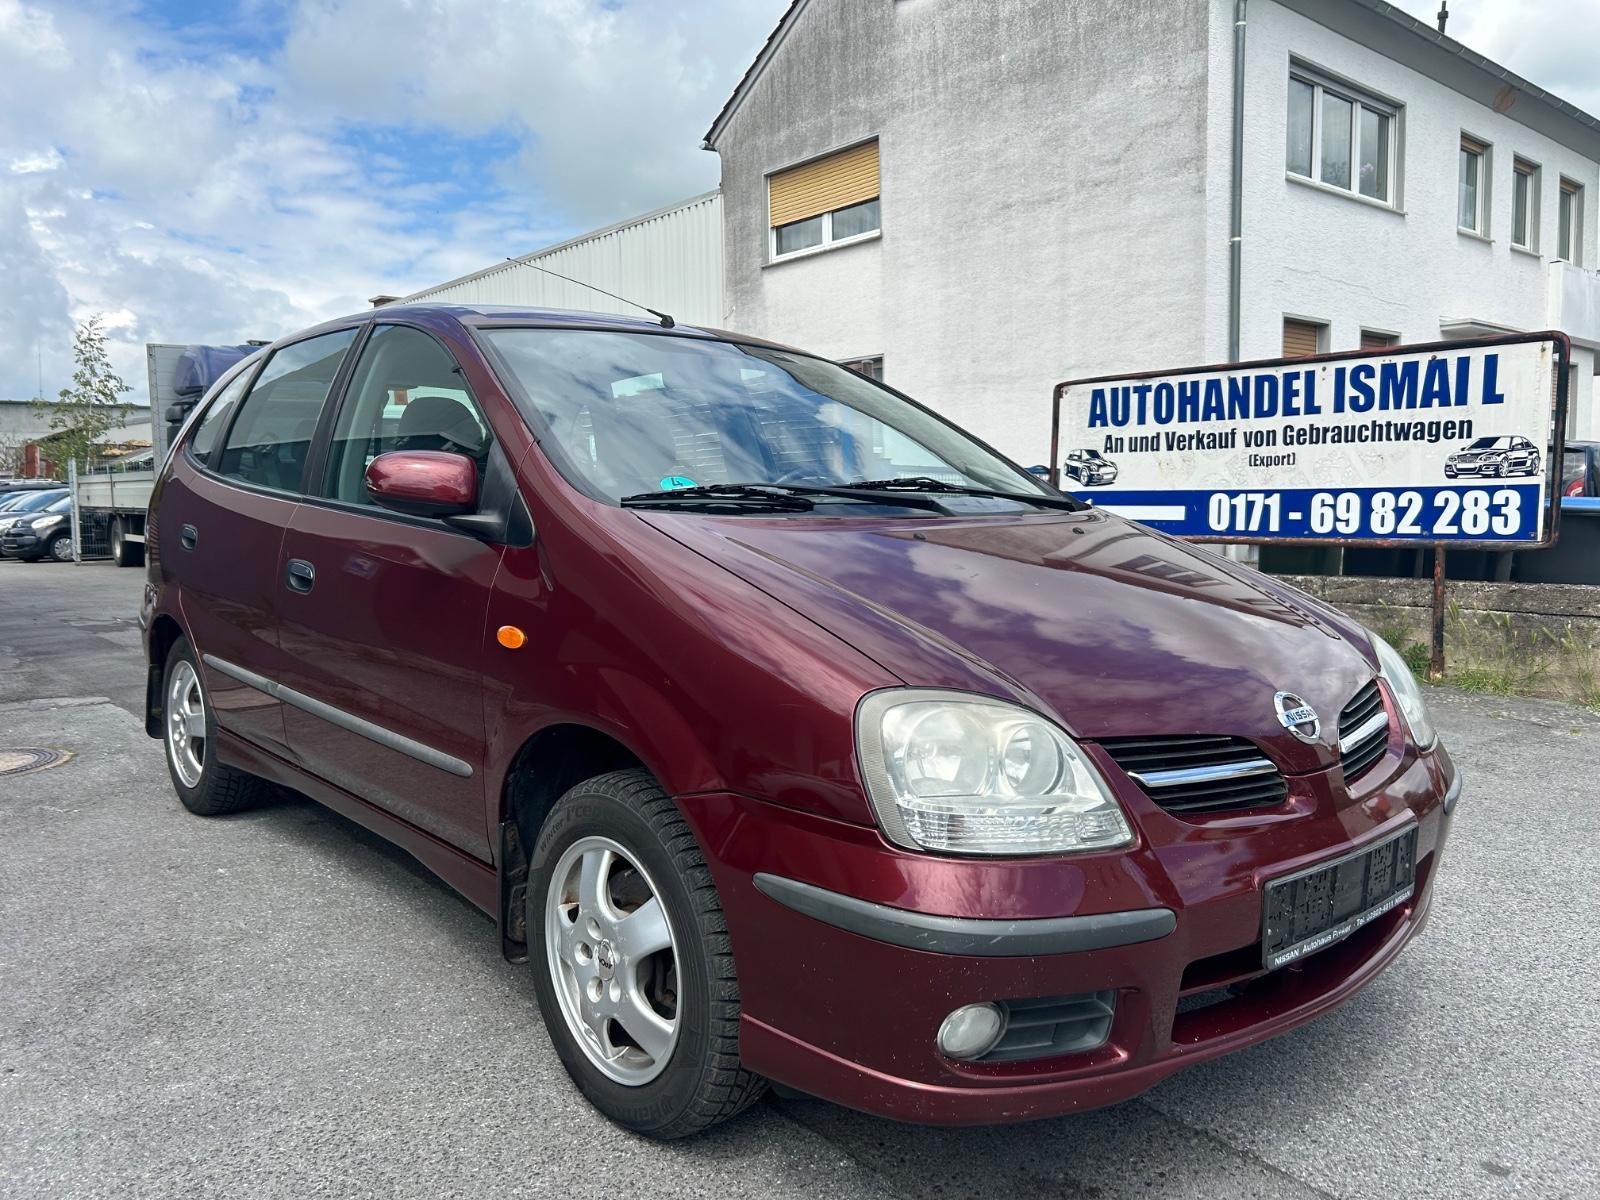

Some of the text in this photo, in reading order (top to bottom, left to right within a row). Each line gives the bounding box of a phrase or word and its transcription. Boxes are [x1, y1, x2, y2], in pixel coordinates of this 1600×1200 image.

[1088, 369, 1321, 428] AUTOHANDEL
[1103, 419, 1473, 454] An und Verkauf von Gebrauchtwagen
[1208, 492, 1281, 532] 0171
[1310, 491, 1361, 535] 69
[1370, 490, 1424, 535] 82
[1432, 489, 1522, 536] 283
[1285, 708, 1316, 722] NISSAN
[1274, 949, 1300, 966] NISSAN
